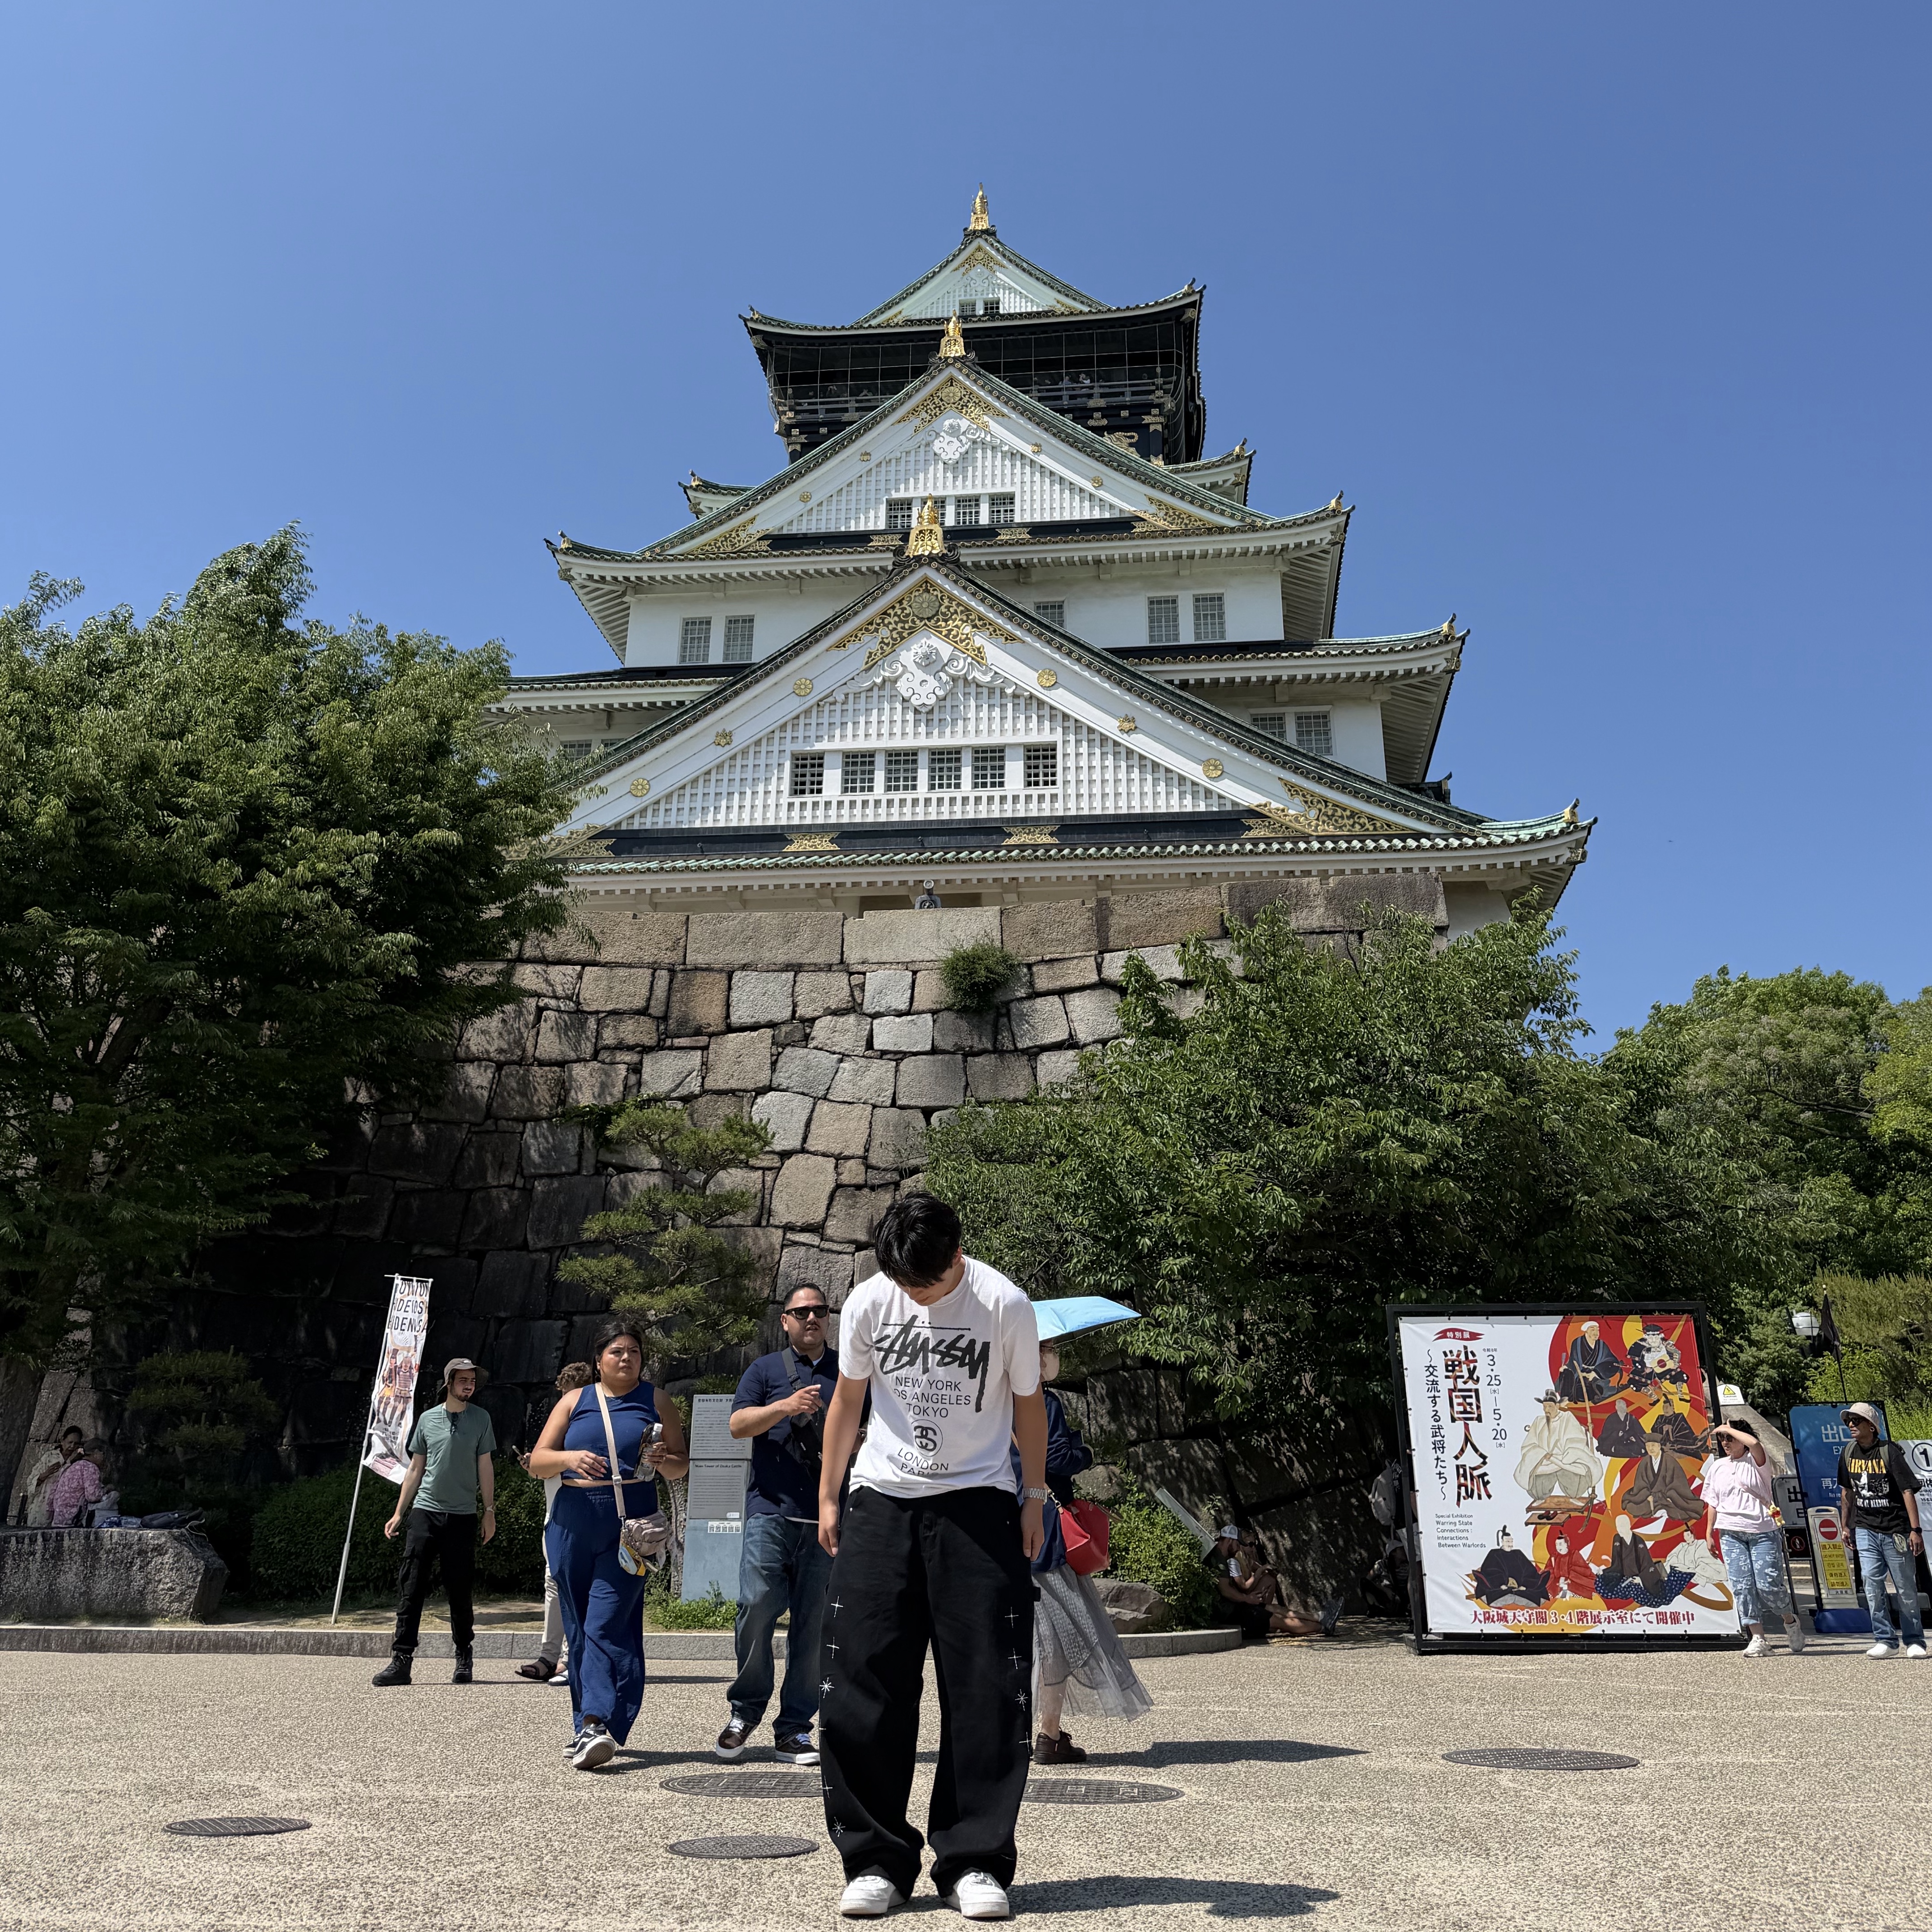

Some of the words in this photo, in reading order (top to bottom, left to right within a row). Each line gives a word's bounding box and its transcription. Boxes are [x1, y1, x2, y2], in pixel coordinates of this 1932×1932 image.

[895, 1376, 923, 1388] NEW
[927, 1379, 961, 1392] YORK
[894, 1388, 907, 1400] OS
[911, 1391, 971, 1405] ANGELES
[906, 1403, 949, 1418] TOKYO
[1442, 1345, 1493, 1508] 戦国人脈
[898, 1447, 949, 1471] LONDON
